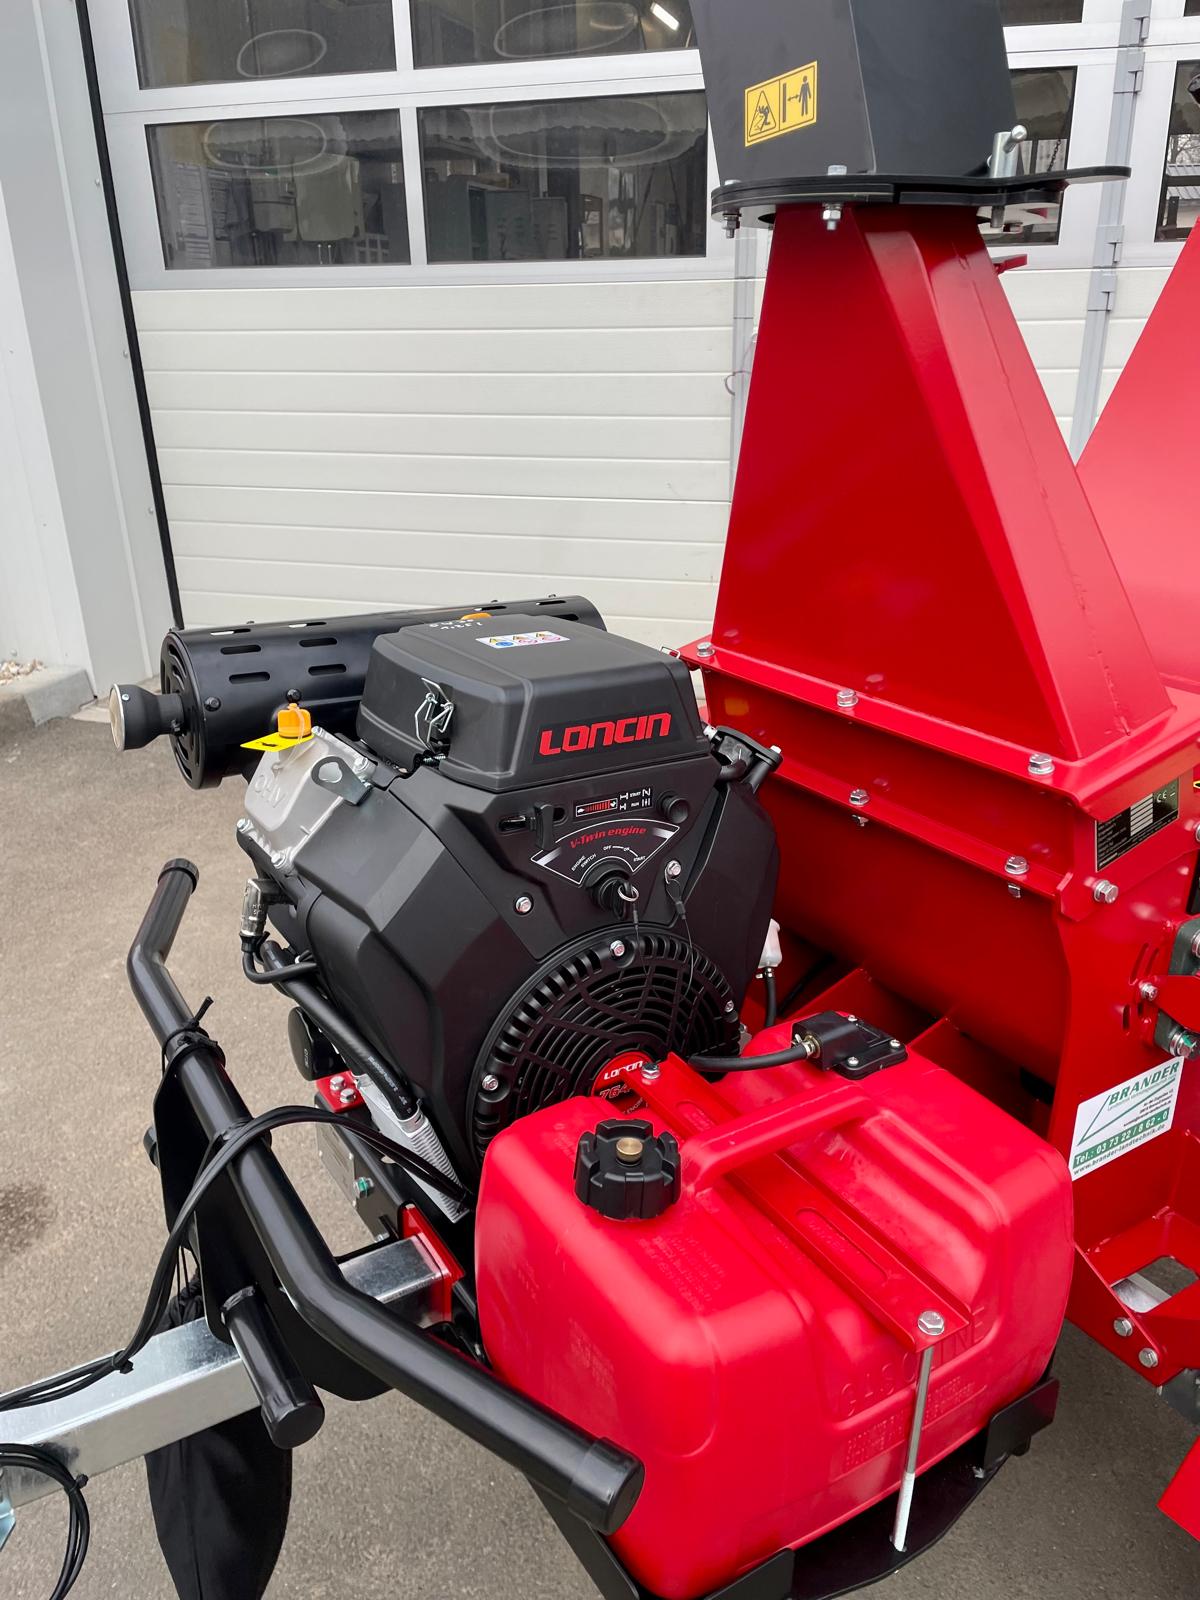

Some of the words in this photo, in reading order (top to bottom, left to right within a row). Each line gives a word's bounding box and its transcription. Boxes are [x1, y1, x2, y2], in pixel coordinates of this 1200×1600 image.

[539, 712, 672, 756] LONCIN
[570, 830, 606, 849] V-Twin
[607, 825, 647, 837] engine
[580, 853, 597, 868] SWITCH
[1108, 1061, 1180, 1106] BRANDER
[1073, 1123, 1166, 1176] www.brander-landtechnik.de
[1075, 1151, 1094, 1163] Tel.:
[1096, 1143, 1106, 1154] 03
[1108, 1137, 1119, 1148] 73
[1120, 1130, 1131, 1142] 22
[1138, 1123, 1143, 1132] 8
[1145, 1118, 1156, 1129] 62
[1162, 1110, 1168, 1120] 0
